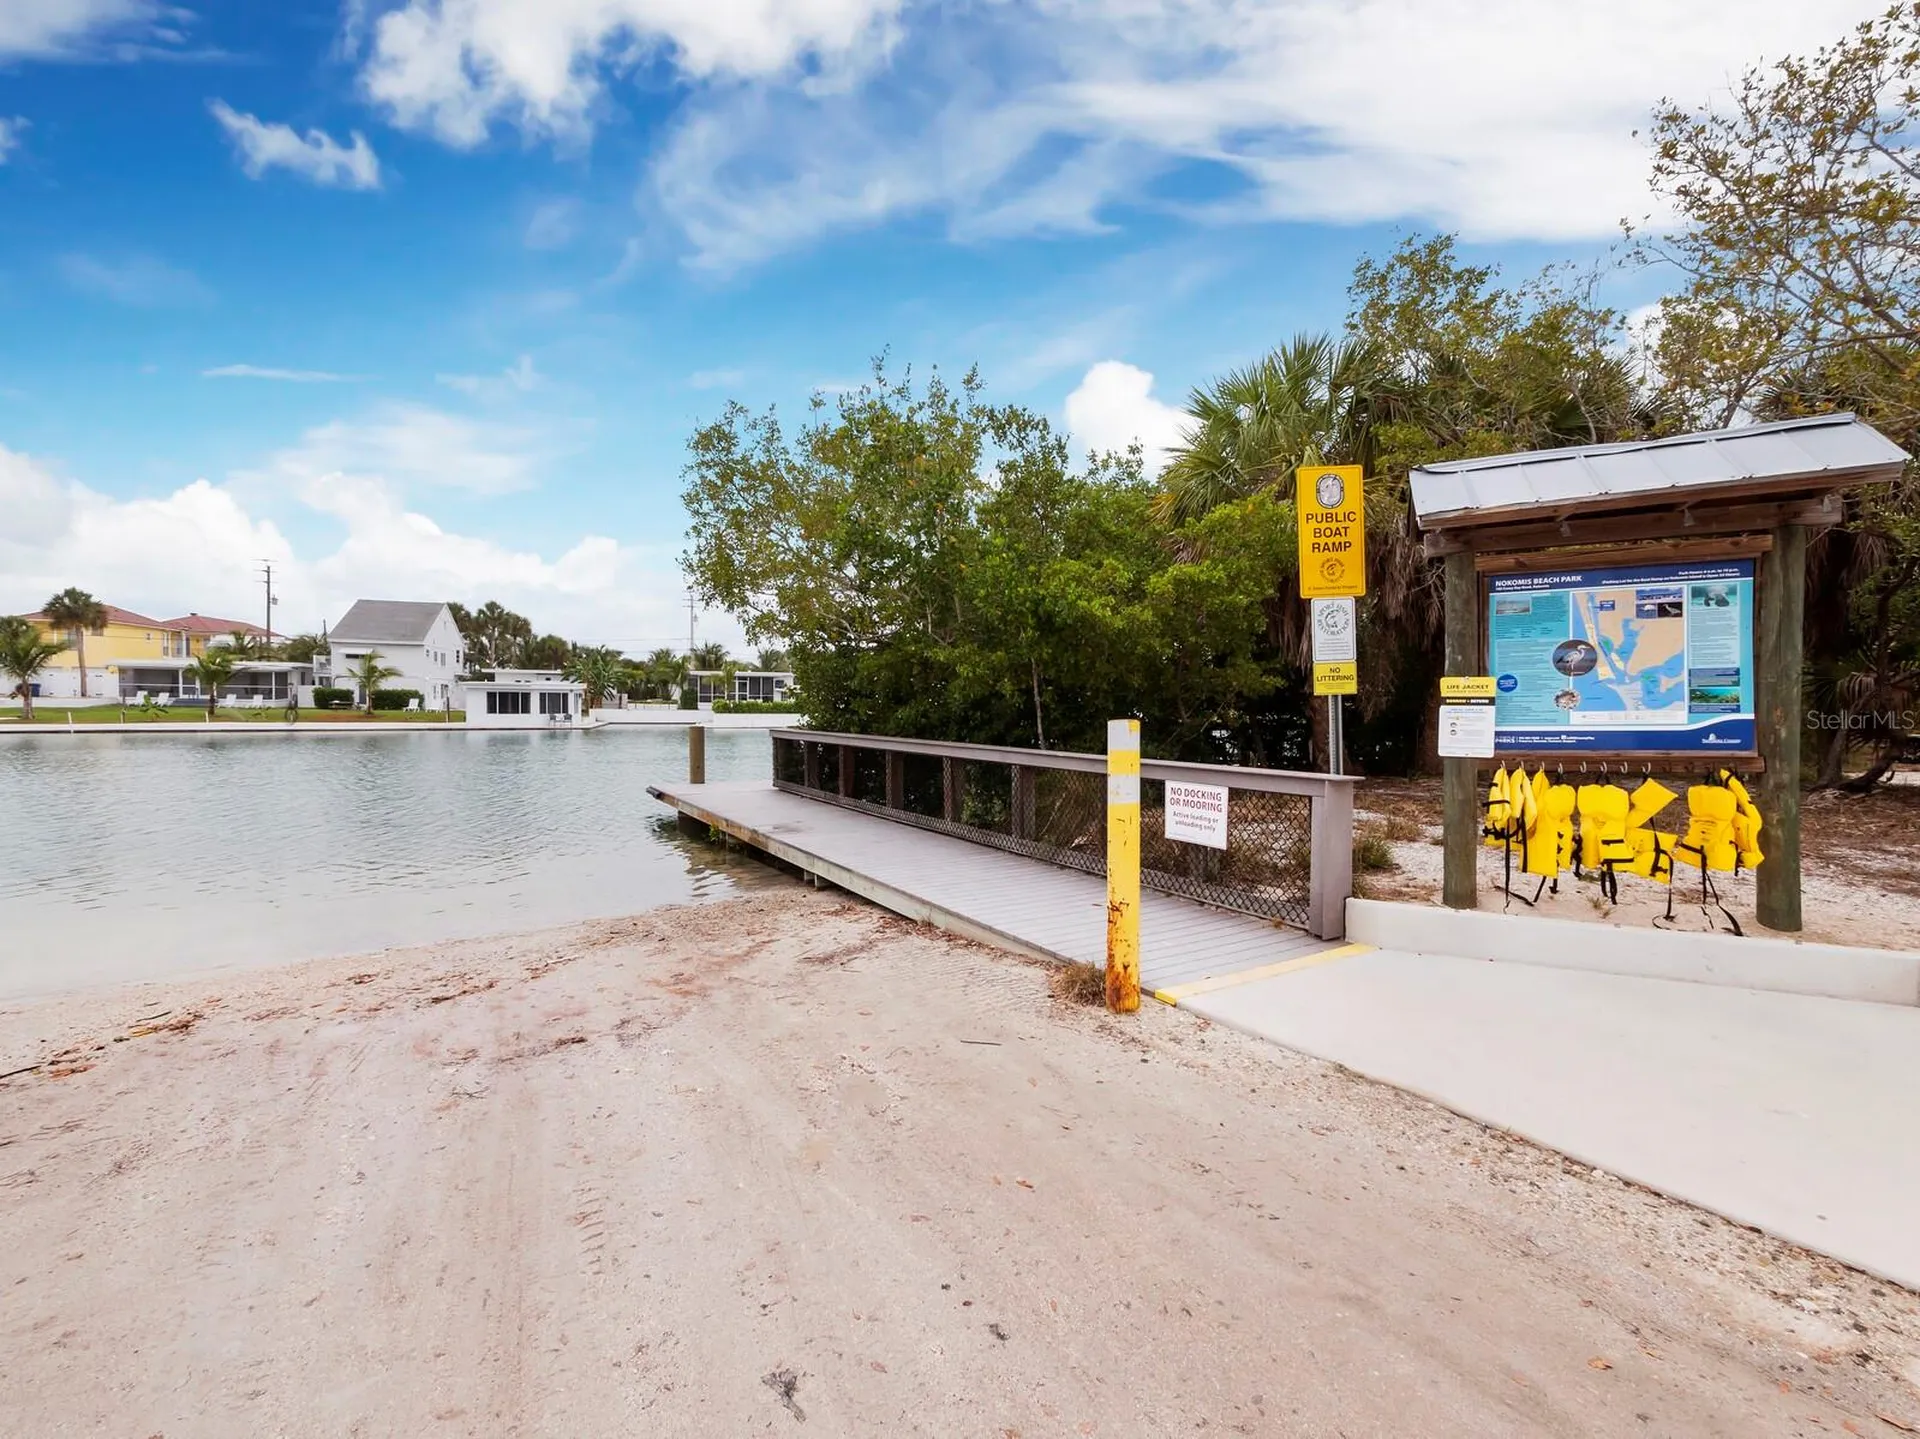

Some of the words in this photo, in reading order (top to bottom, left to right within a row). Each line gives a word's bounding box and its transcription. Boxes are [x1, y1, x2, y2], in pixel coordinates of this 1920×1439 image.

[1306, 511, 1357, 524] PUBLIC
[1313, 526, 1350, 538] BOAT
[1312, 541, 1352, 553] RAMP
[1495, 578, 1532, 587] NOKOMIS
[1533, 576, 1560, 585] BEACH
[1561, 575, 1582, 583] PARK
[1316, 674, 1354, 682] LITTERING
[1170, 787, 1182, 796] NO
[1184, 788, 1222, 802] DOCKING
[1169, 797, 1181, 806] OR
[1182, 799, 1222, 813] MOORING
[1190, 812, 1212, 824] loading
[1175, 820, 1203, 831] unloading
[1204, 825, 1216, 833] only
